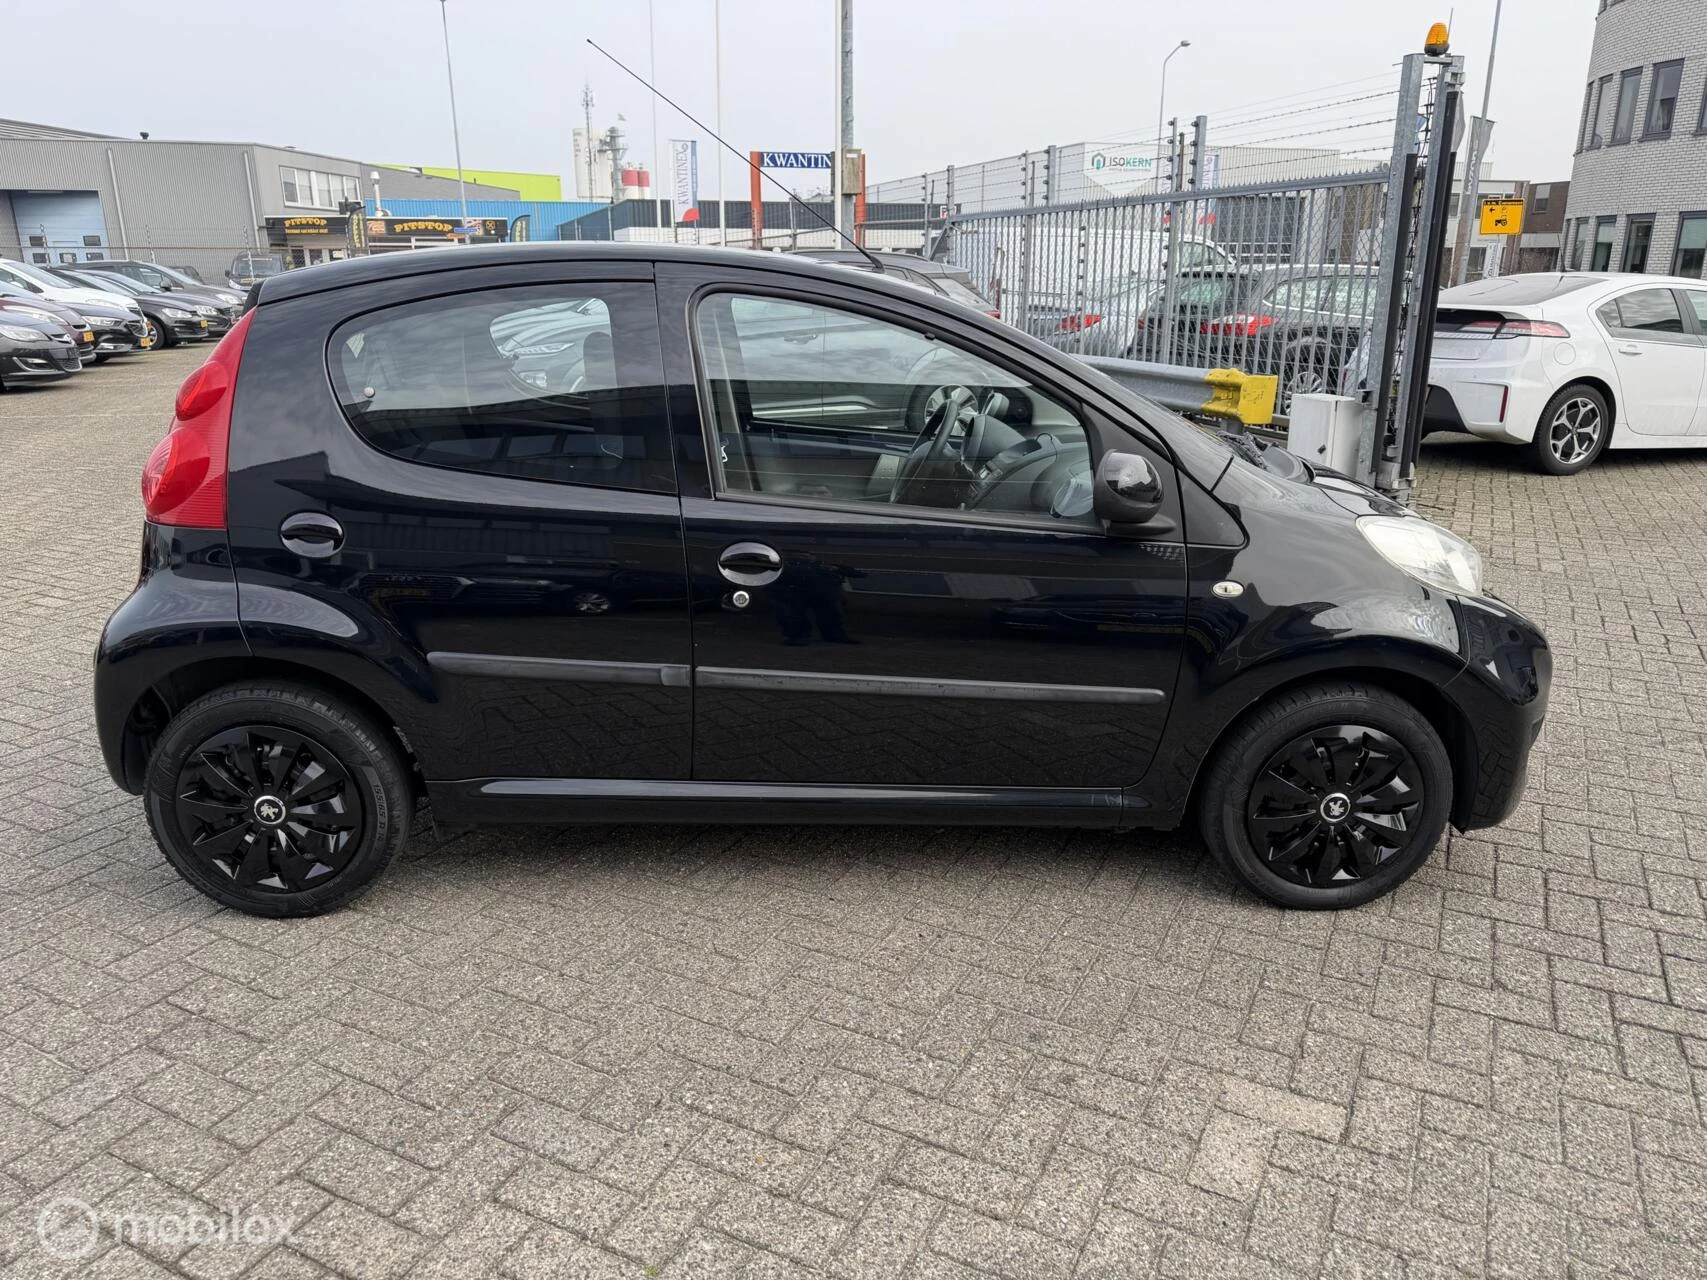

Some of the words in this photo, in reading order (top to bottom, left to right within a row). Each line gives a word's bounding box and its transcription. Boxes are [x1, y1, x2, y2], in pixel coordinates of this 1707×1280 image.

[1109, 157, 1152, 167] ISOKERN
[676, 149, 689, 205] KWANTINEX
[284, 217, 328, 227] PITSTOP
[394, 221, 453, 232] PITSTOP
